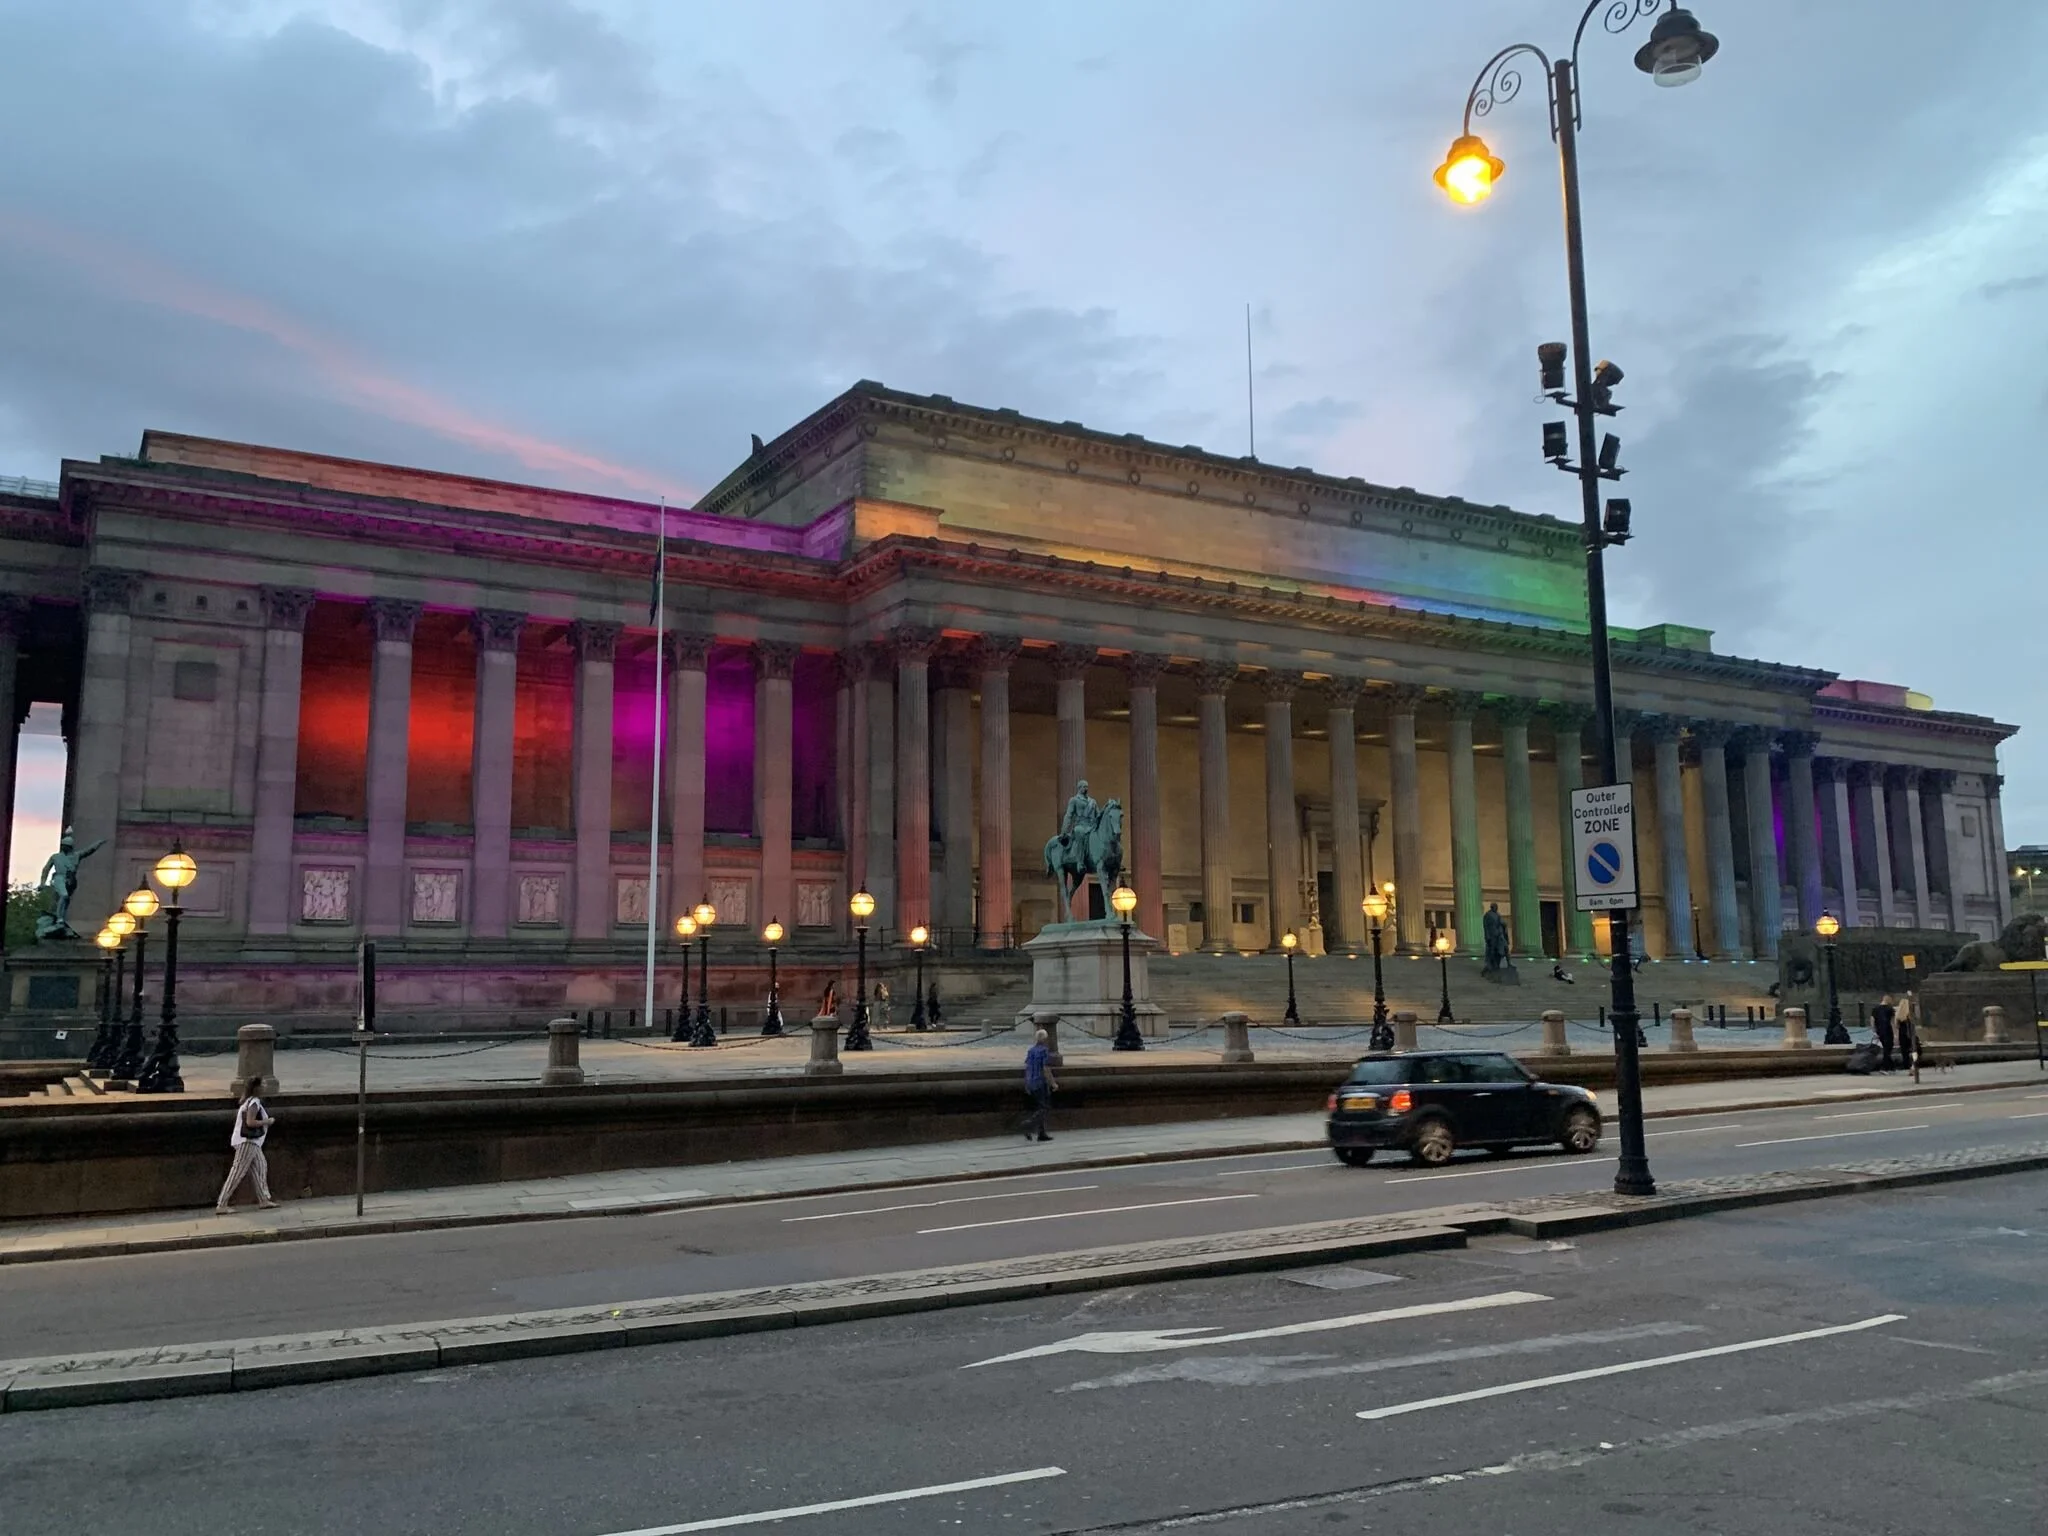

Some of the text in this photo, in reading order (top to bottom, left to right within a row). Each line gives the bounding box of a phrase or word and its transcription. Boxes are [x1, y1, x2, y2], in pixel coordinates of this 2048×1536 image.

[1586, 792, 1616, 804] Outer
[1574, 803, 1630, 819] Controlled
[1584, 818, 1620, 834] ZONE
